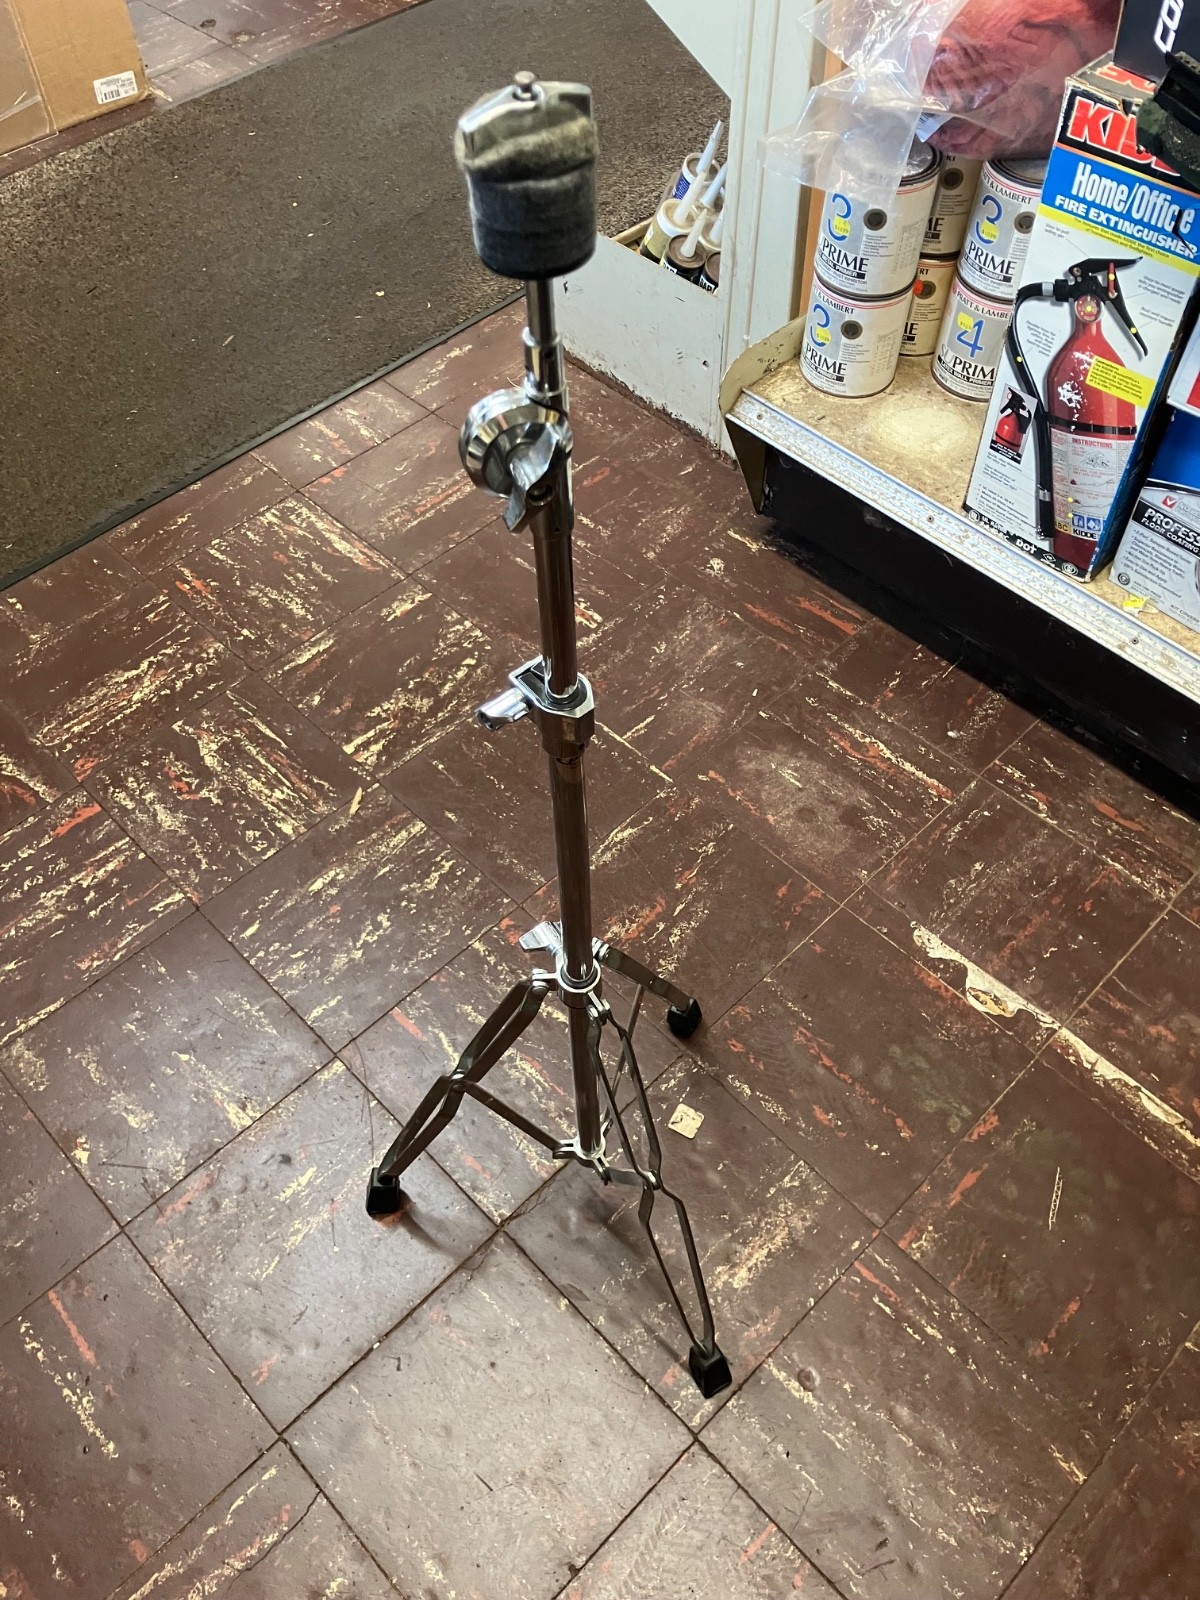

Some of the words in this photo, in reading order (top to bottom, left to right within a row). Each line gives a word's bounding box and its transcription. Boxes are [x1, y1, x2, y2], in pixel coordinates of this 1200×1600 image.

[1154, 0, 1184, 53] CO
[995, 184, 1033, 204] LAMBERT
[1071, 162, 1195, 234] Home/Office
[1055, 195, 1087, 217] FIRE
[1088, 207, 1198, 259] EXTINGUISHER
[822, 238, 869, 272] PRIME
[968, 240, 1017, 275] PRIME
[822, 295, 855, 315] LAMBERT
[956, 291, 973, 308] PRATT
[956, 319, 984, 358] 4
[804, 342, 847, 376] PRIME
[1072, 437, 1113, 449] INSTRUCTIONS
[1073, 528, 1097, 539] KIDDE
[1141, 518, 1165, 535] FLOOR
[1166, 531, 1199, 554] COATING
